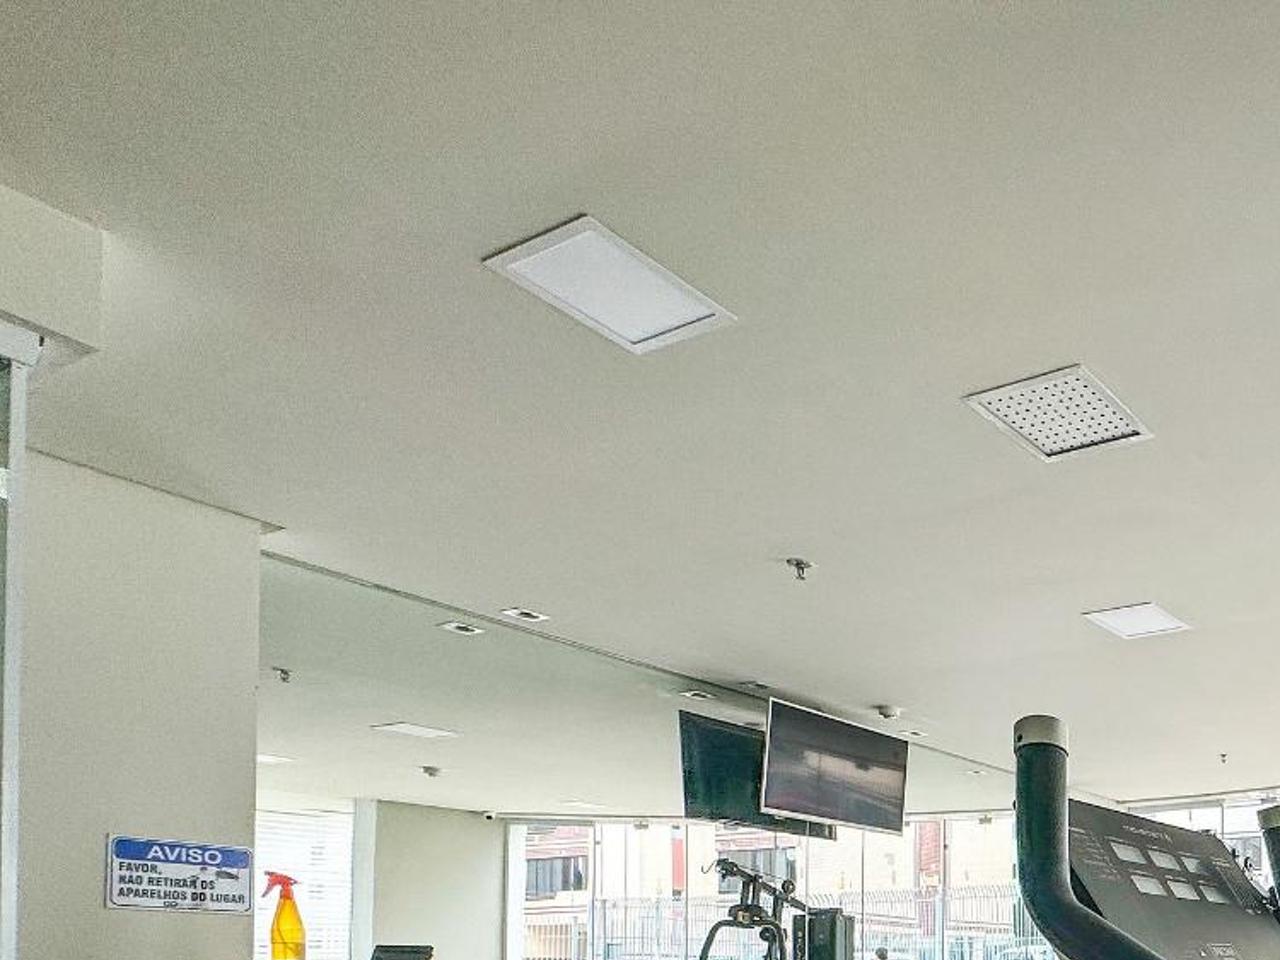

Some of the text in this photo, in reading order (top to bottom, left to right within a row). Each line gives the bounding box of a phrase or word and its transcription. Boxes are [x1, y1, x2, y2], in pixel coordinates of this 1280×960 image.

[147, 844, 222, 865] AVISO
[118, 861, 163, 875] FAVOR,
[147, 876, 198, 890] RETIRAR
[200, 879, 216, 890] OS
[117, 886, 188, 901] APARELHOS
[190, 892, 207, 903] DO
[210, 893, 245, 905] LUGAR
